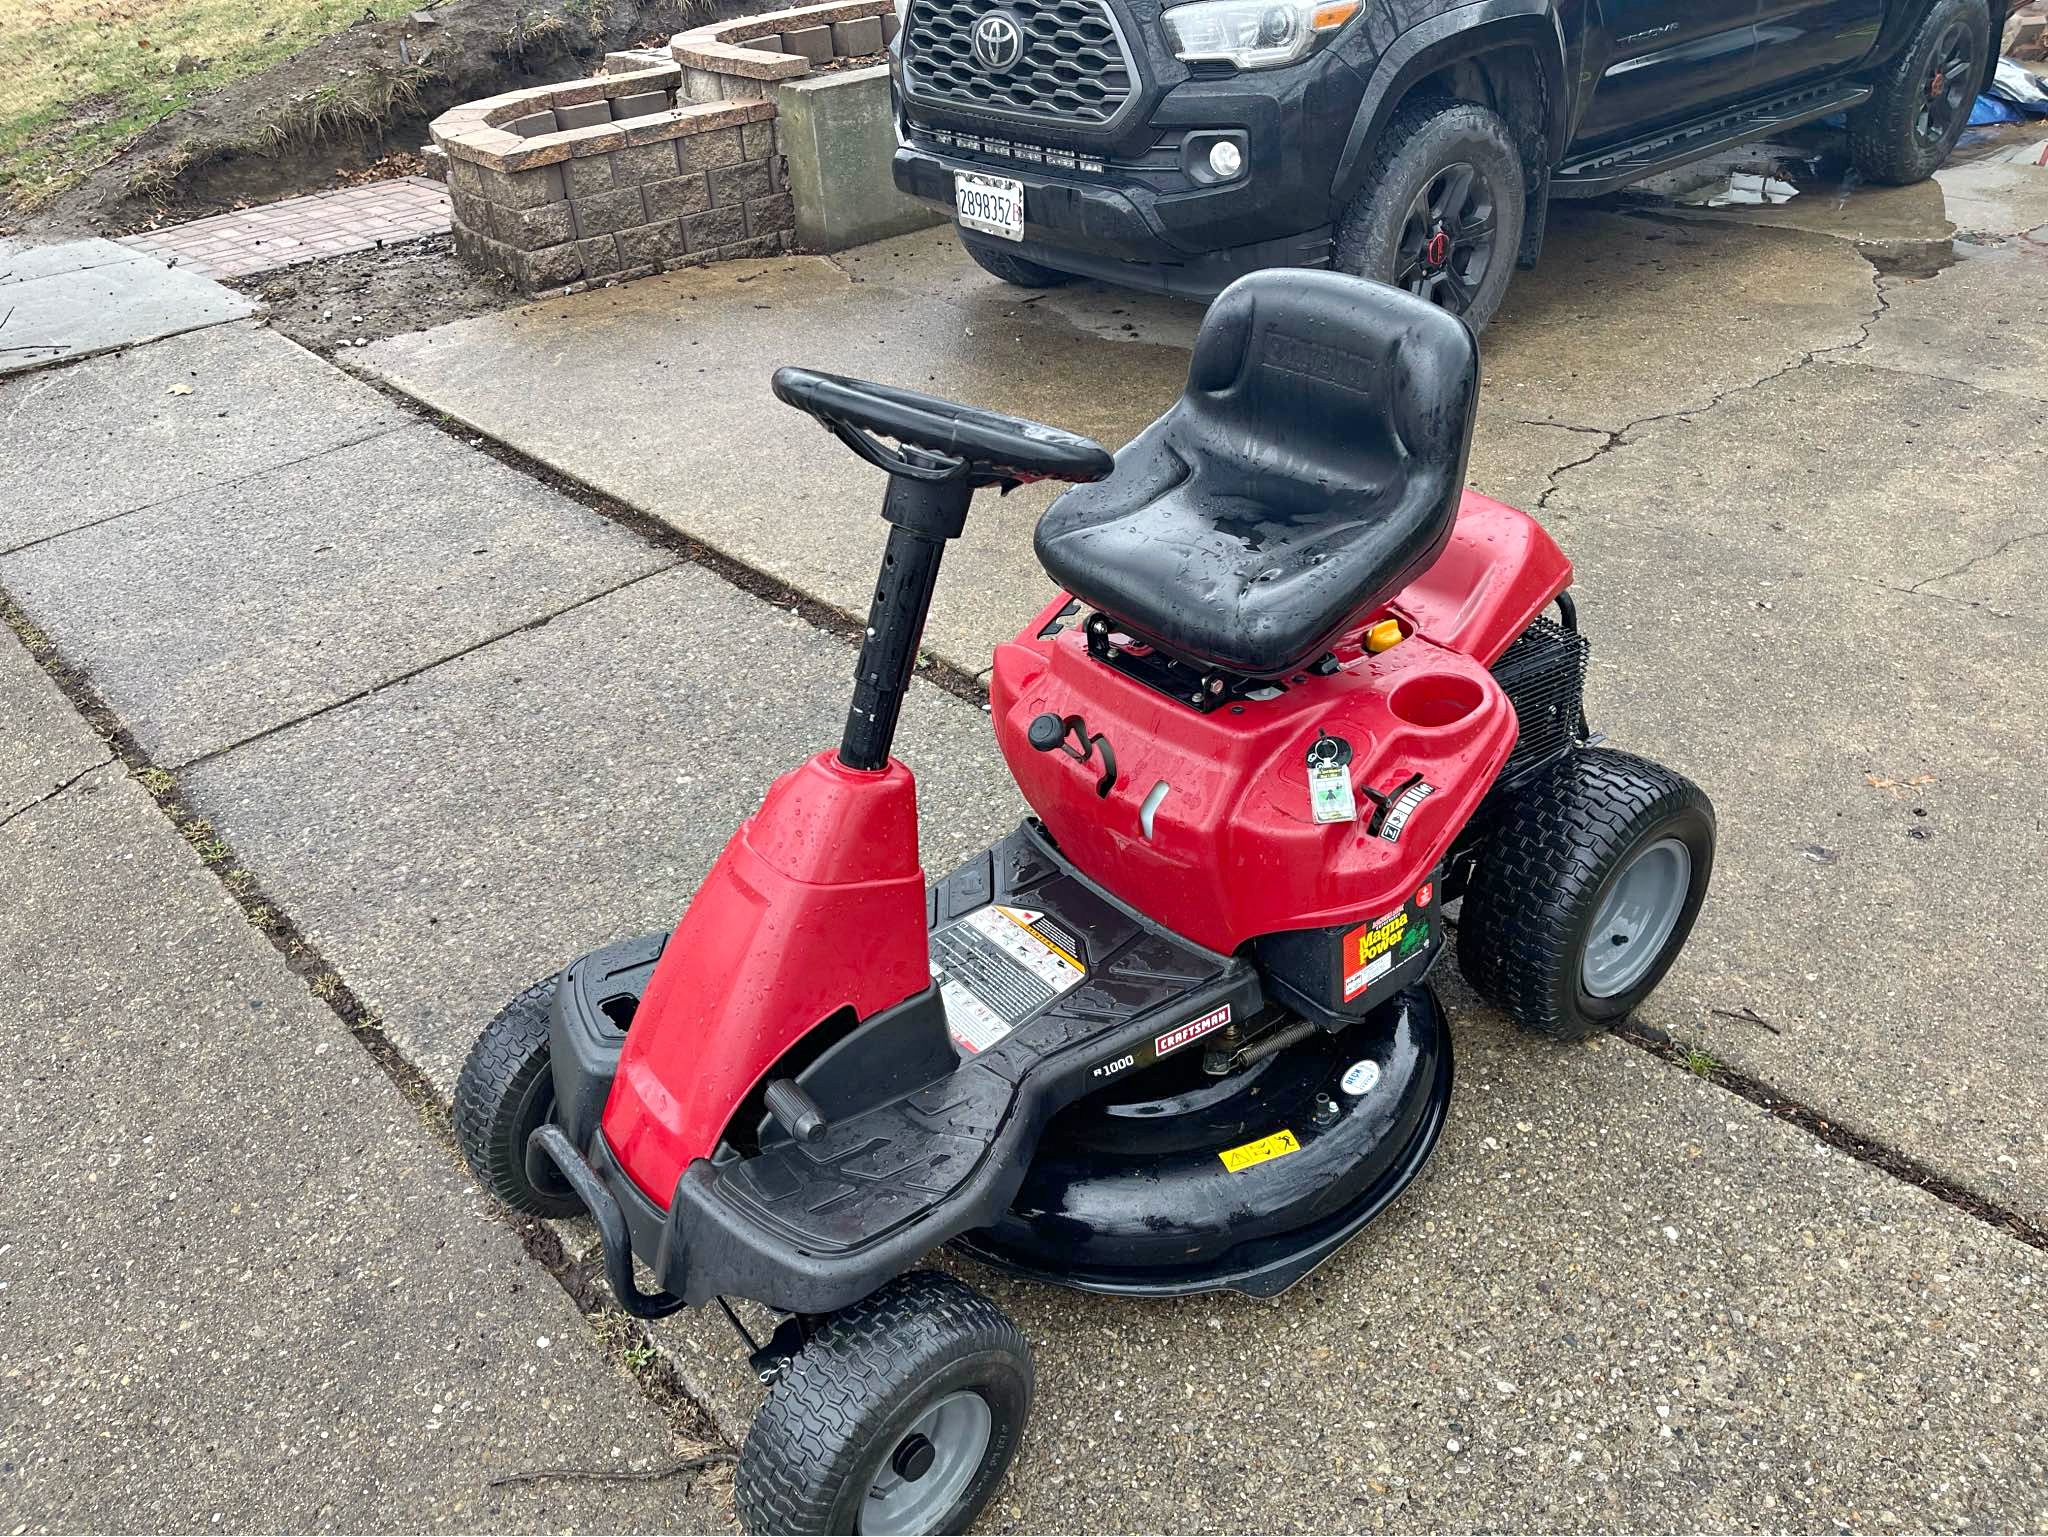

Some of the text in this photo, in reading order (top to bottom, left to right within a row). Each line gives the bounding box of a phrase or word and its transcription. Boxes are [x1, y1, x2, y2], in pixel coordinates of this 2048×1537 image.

[959, 188, 1012, 226] 2898352
[1359, 912, 1409, 950] Magna
[1359, 928, 1404, 966] Power
[1160, 1010, 1226, 1050] CRAFTSMAN
